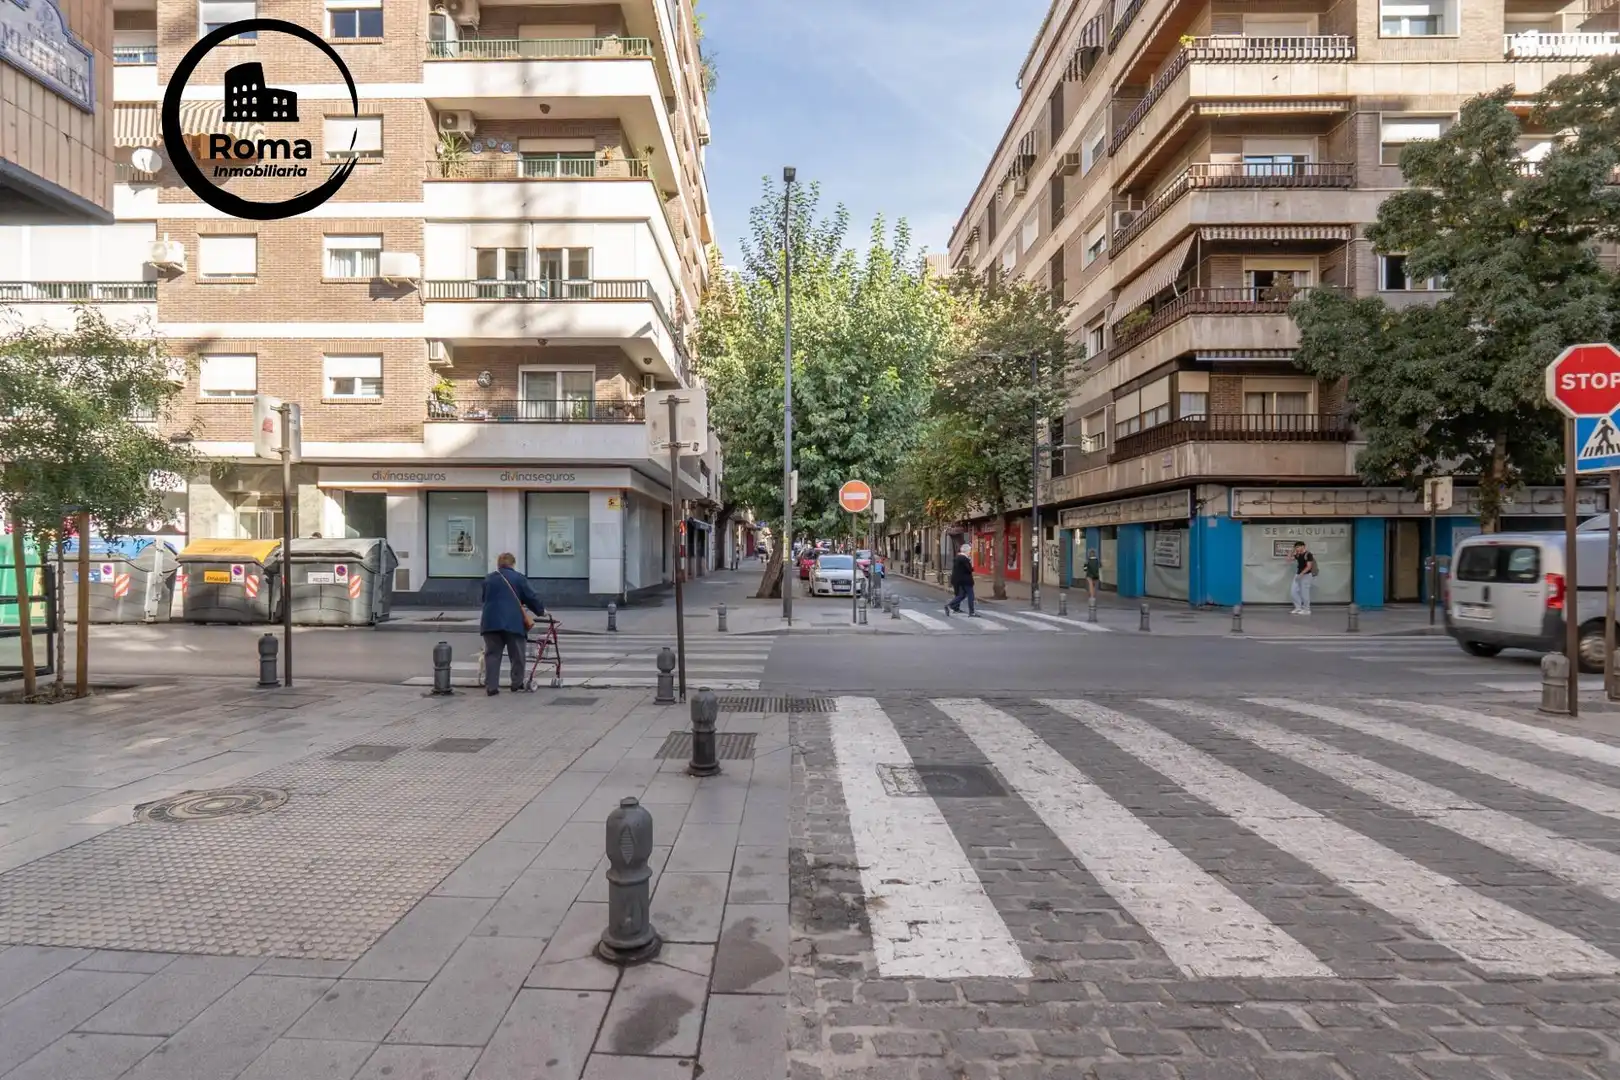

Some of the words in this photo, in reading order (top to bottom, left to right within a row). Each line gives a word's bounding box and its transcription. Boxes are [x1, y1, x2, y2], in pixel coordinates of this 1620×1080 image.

[1560, 372, 1620, 390] STOP
[371, 467, 446, 483] divinaseguros
[500, 468, 575, 484] divinaseguros
[1264, 527, 1278, 536] SE
[1288, 527, 1346, 536] ALQUILA
